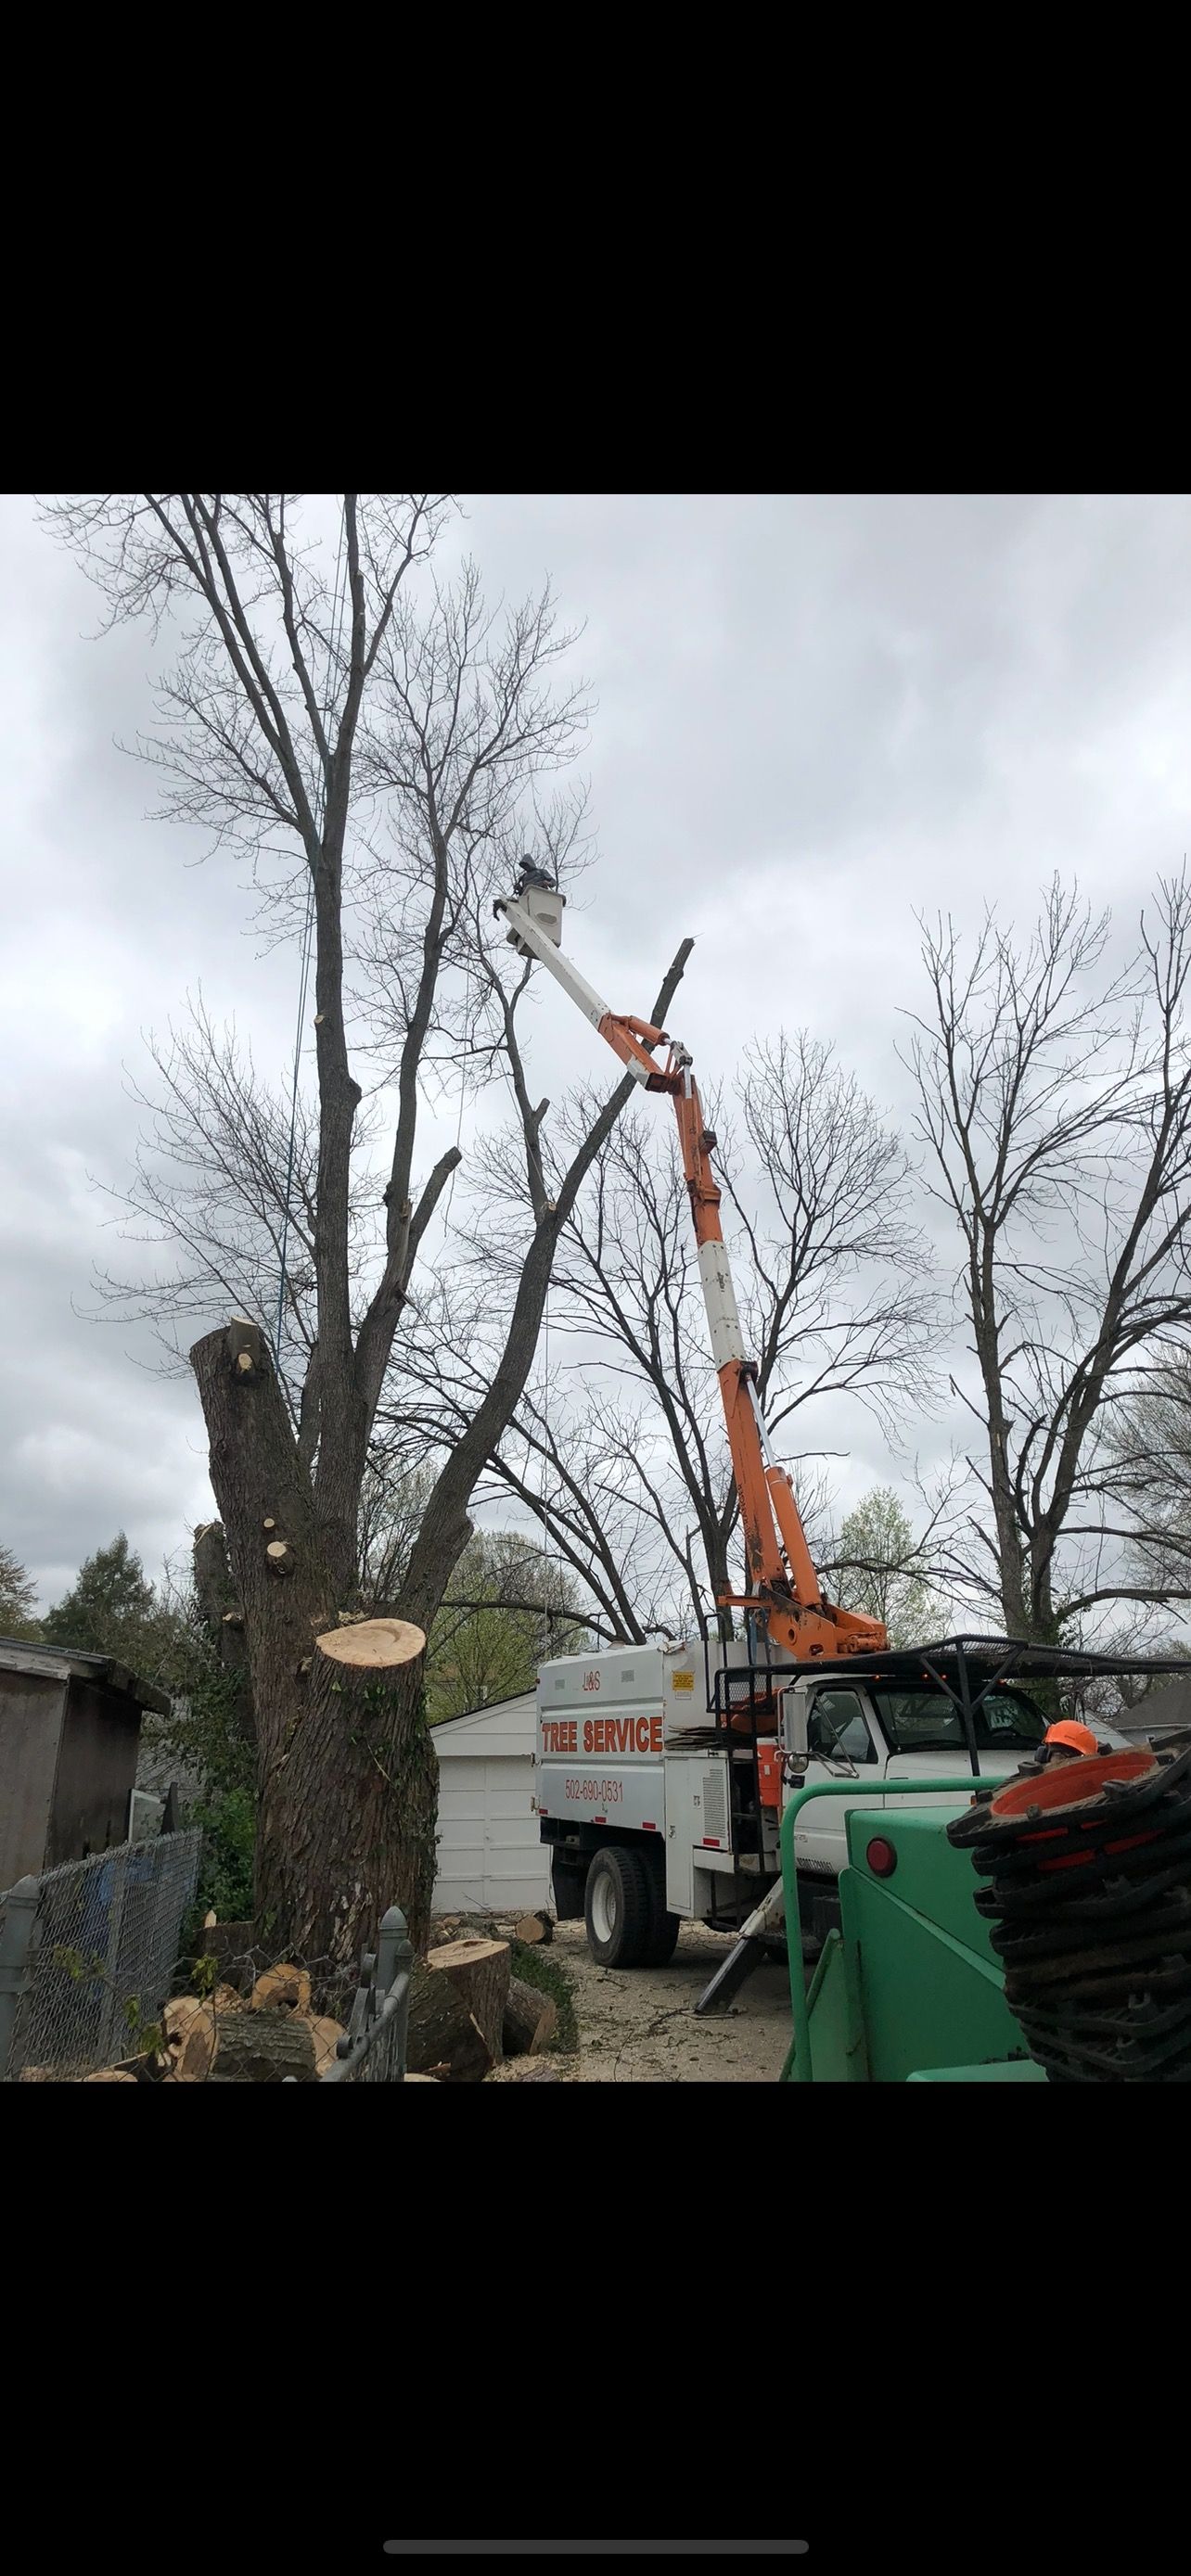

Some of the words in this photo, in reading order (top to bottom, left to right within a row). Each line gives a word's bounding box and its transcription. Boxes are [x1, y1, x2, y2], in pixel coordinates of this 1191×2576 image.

[542, 1721, 577, 1752] TREE
[583, 1716, 663, 1753] SERVICE
[565, 1779, 622, 1802] 502-690-0531
